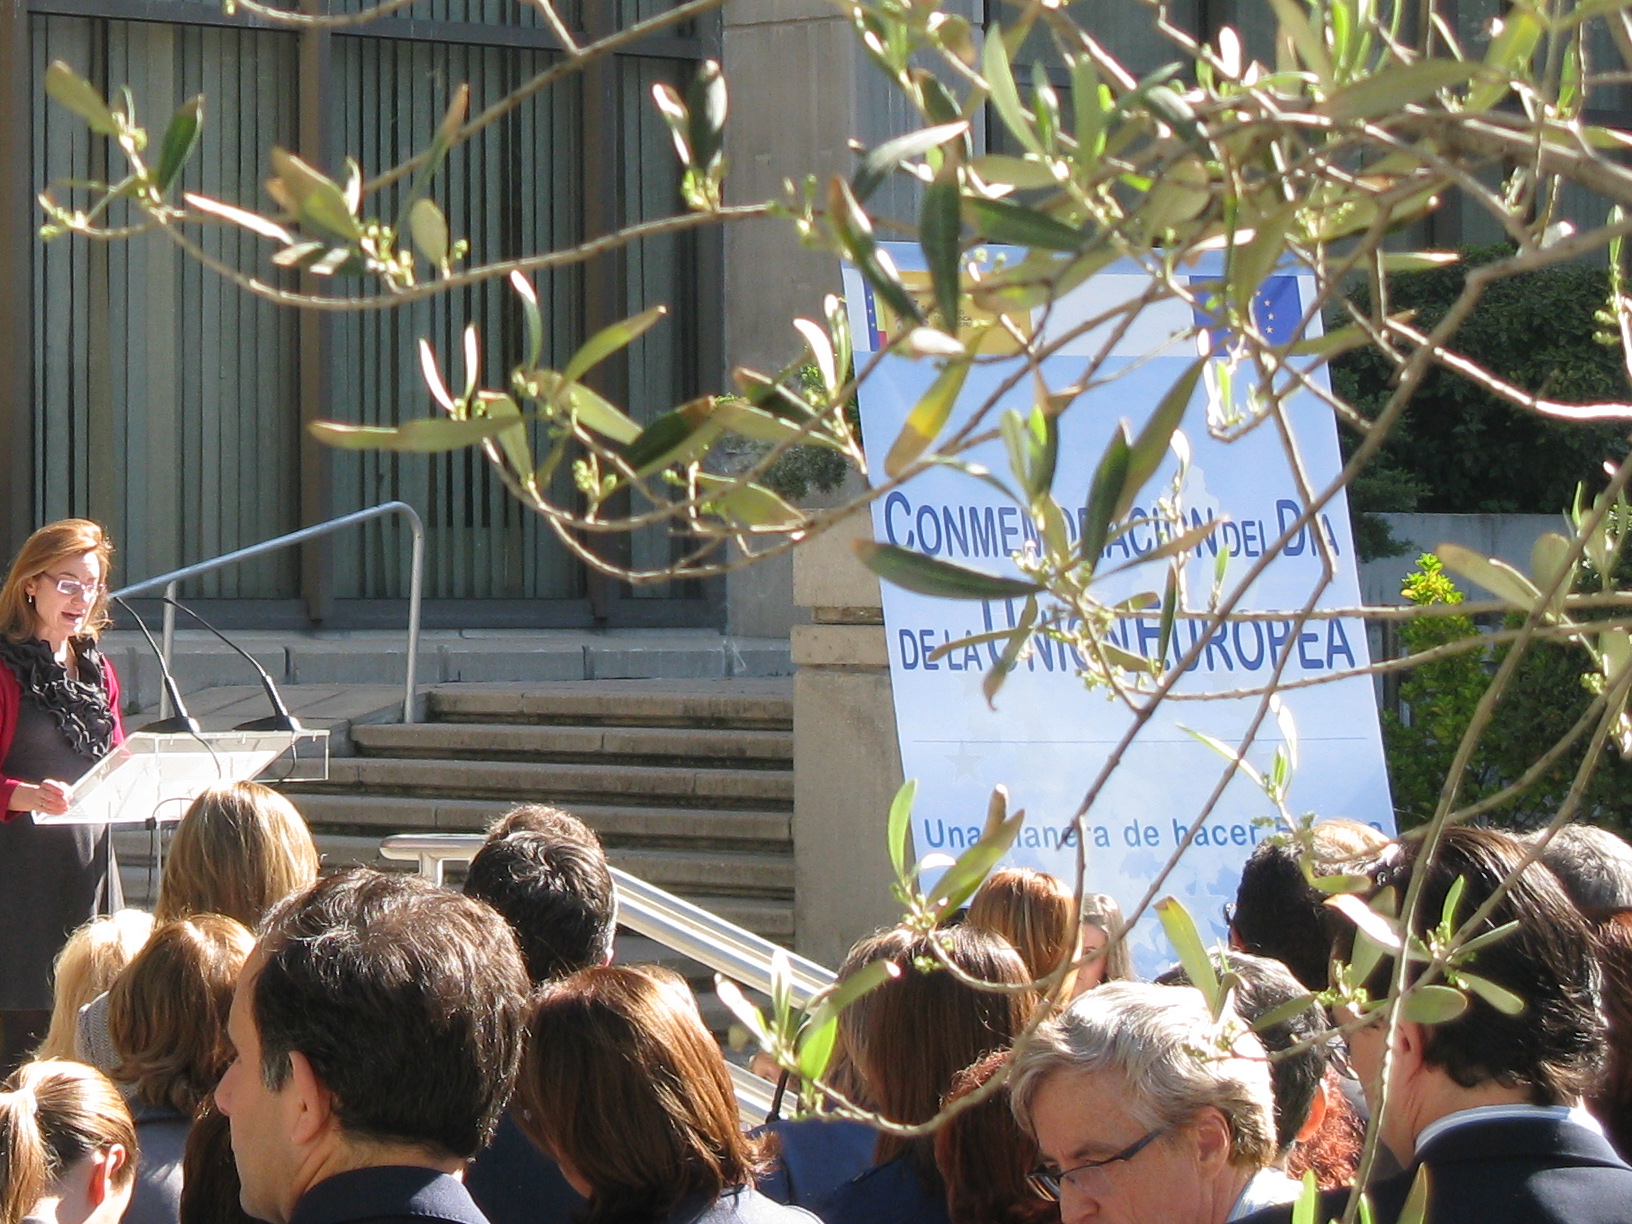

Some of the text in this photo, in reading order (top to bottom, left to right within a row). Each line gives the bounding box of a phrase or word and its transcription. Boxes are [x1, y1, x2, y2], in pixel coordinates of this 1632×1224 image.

[898, 628, 940, 671] DE
[944, 629, 983, 671] LA
[923, 818, 981, 849] Una
[1123, 818, 1161, 848] de
[1171, 817, 1260, 847] hacer
